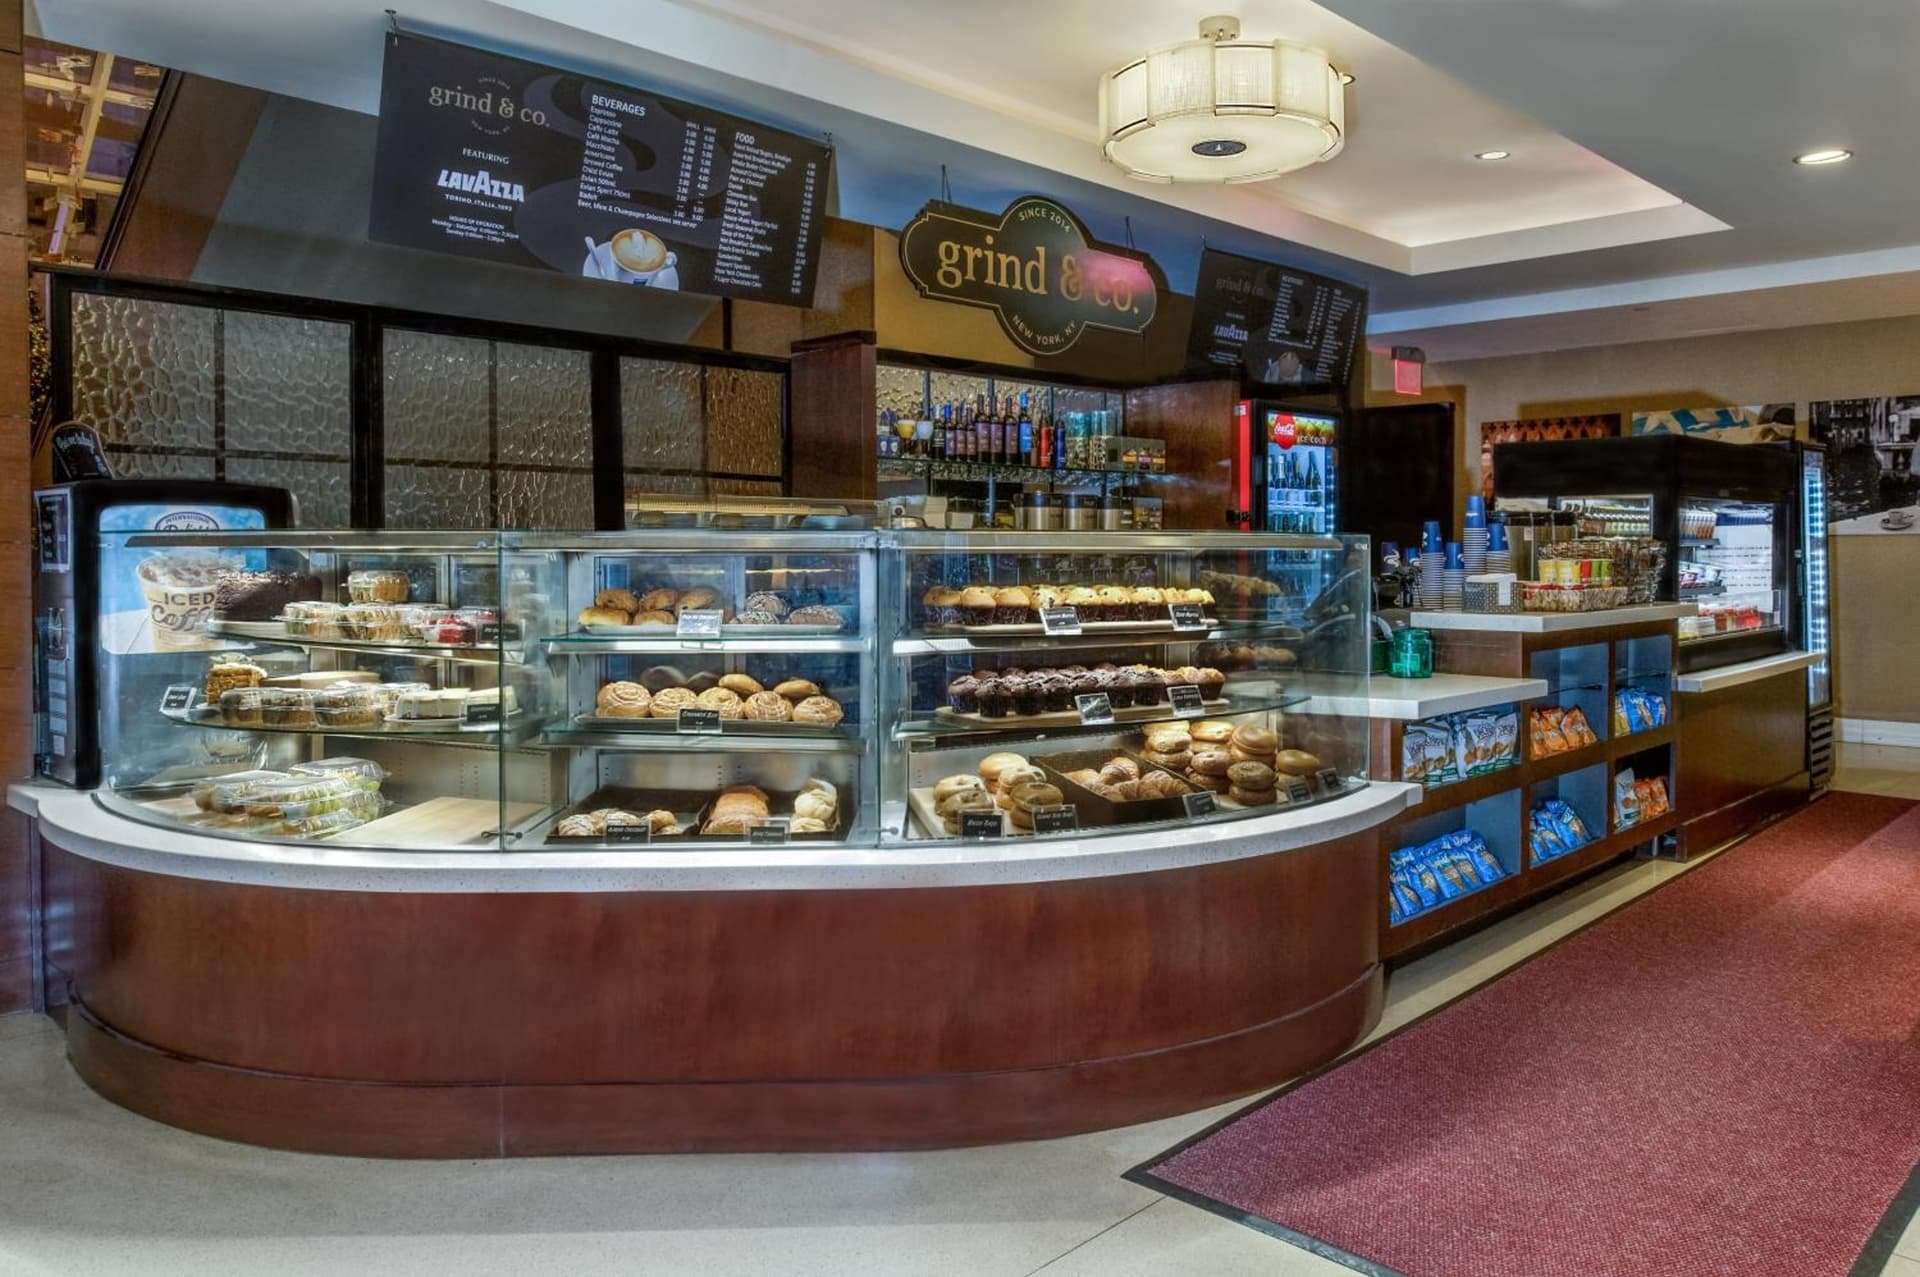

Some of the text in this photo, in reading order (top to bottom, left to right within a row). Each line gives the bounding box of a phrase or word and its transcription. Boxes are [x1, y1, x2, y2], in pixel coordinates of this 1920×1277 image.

[429, 85, 492, 114] grind
[499, 97, 514, 118] &
[520, 110, 550, 128] co.
[592, 95, 646, 117] BEVERAGES
[736, 131, 755, 145] FOOD
[462, 147, 510, 165] FEATURING
[437, 169, 525, 202] LAVAZZA
[1019, 207, 1071, 233] SINCE 2014
[936, 235, 1139, 315] grind & co.
[1011, 314, 1077, 346] NEW YORK, NY
[164, 592, 215, 606] ICED
